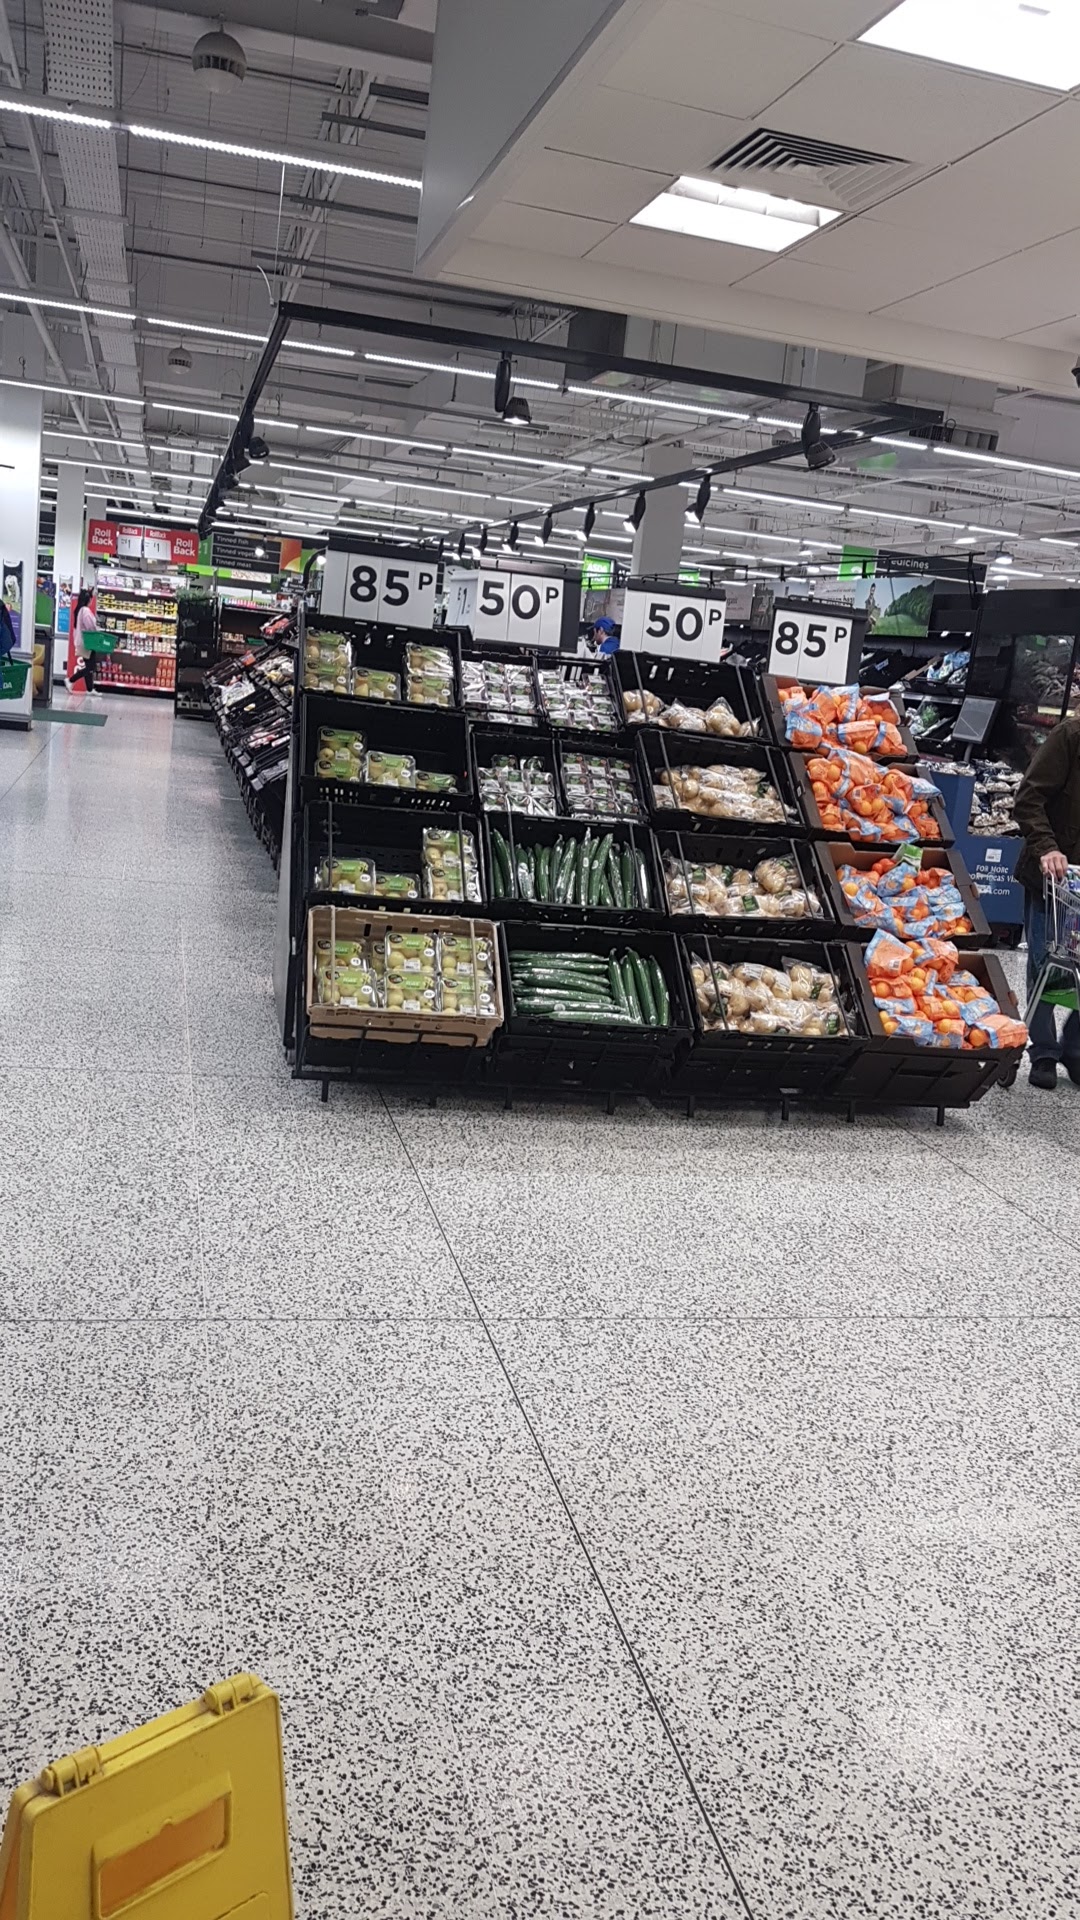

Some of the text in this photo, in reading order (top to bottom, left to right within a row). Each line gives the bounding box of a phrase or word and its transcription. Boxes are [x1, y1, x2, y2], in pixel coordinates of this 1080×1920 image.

[94, 527, 111, 537] Roll
[92, 535, 113, 546] Back
[176, 538, 193, 548] Roll
[216, 535, 249, 546] Tinned fish
[173, 545, 195, 557] Back
[216, 547, 237, 555] Tinned
[215, 558, 236, 567] Tinned
[884, 558, 930, 570] edicines
